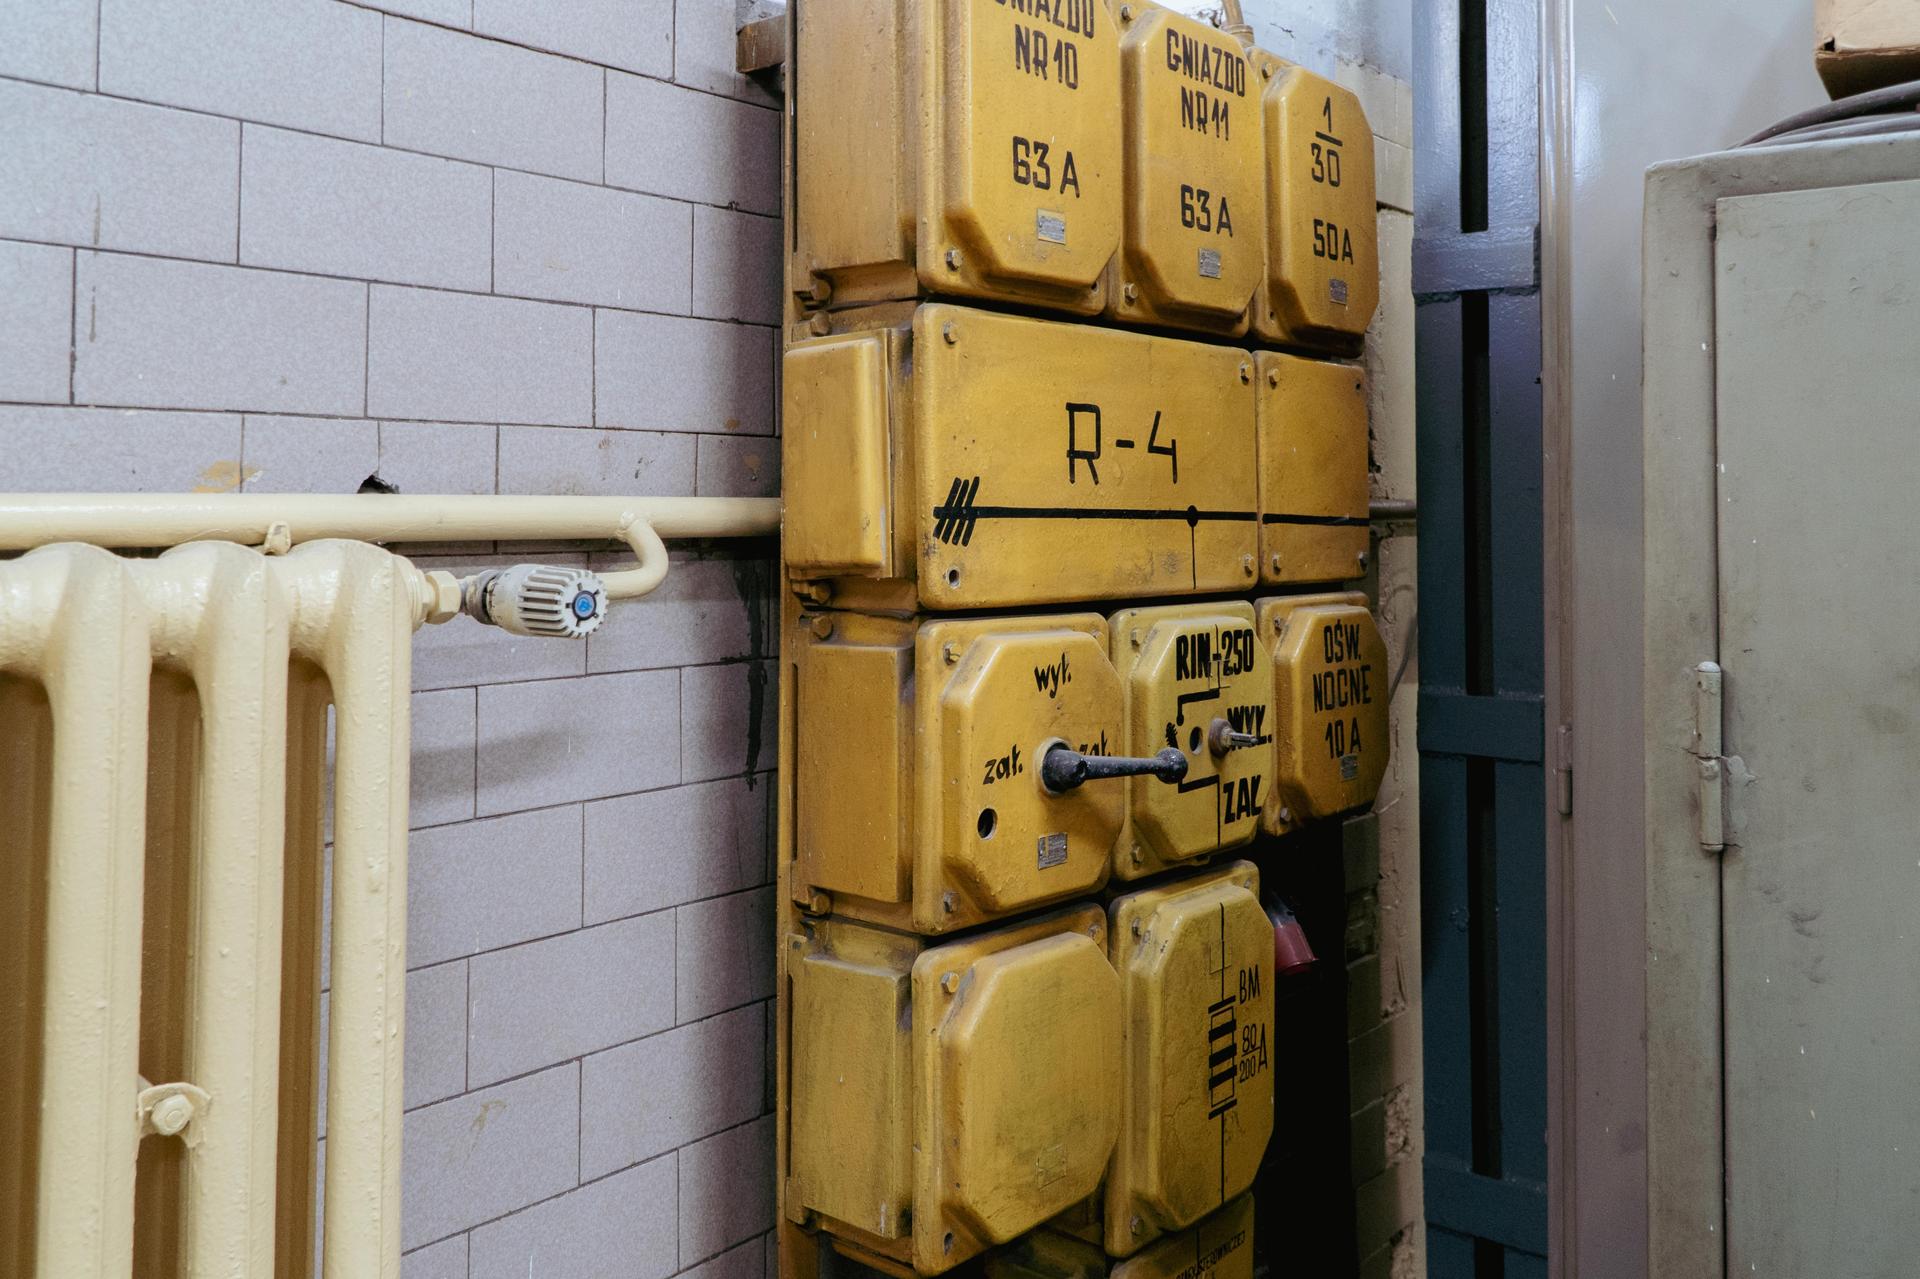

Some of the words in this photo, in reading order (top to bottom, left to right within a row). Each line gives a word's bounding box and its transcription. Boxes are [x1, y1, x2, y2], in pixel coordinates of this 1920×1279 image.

[1167, 28, 1245, 97] GNIAZDO
[1012, 136, 1050, 190] 63
[1060, 151, 1080, 198] A
[1311, 143, 1340, 187] 30
[1181, 184, 1211, 232] 63
[1216, 197, 1233, 237] A
[1323, 619, 1361, 664] OŚW.
[1313, 664, 1372, 713] NOCNE
[1240, 965, 1260, 1005] BM
